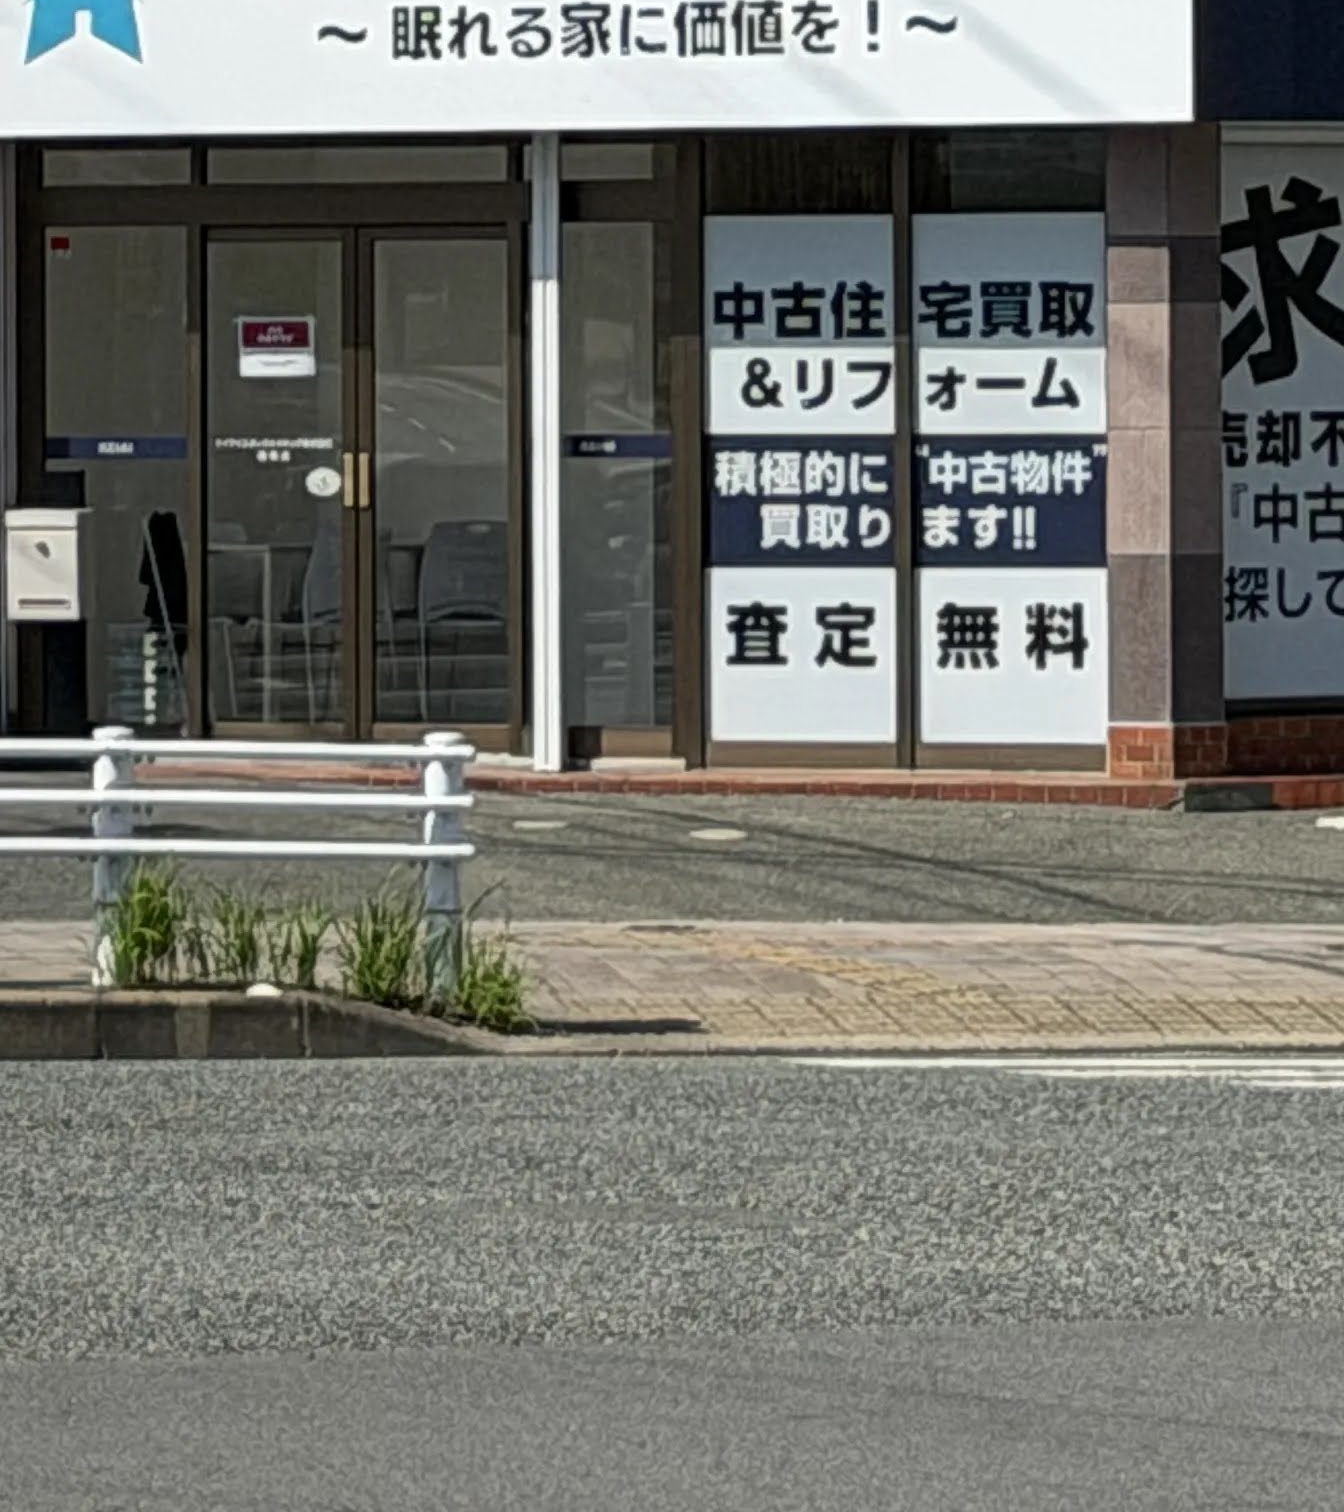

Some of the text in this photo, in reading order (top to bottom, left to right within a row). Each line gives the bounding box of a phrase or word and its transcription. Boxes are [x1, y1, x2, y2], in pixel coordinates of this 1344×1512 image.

[712, 280, 1095, 340] 中古住宅買取
[740, 356, 1081, 411] &リフォーム
